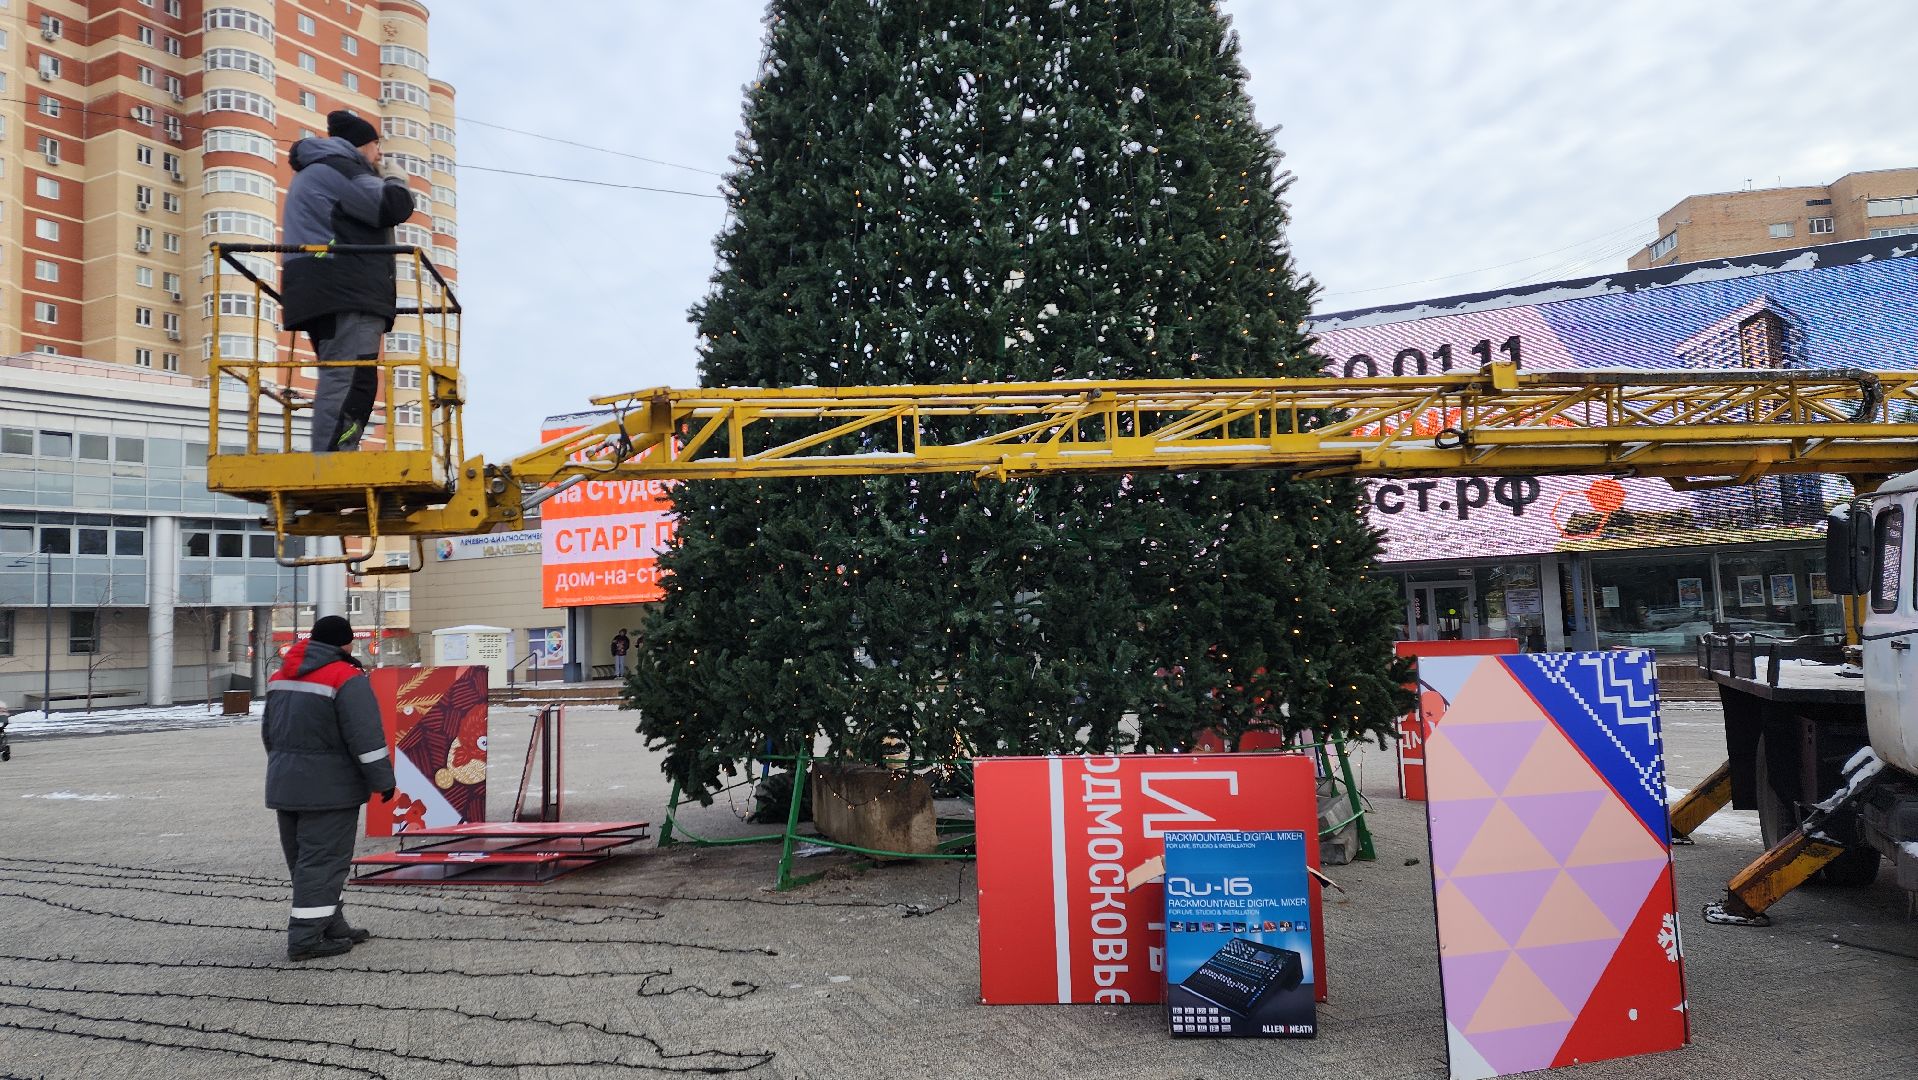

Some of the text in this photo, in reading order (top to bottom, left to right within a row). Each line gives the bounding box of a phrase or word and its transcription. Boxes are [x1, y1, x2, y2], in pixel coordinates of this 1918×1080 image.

[586, 479, 672, 505] Студе
[1360, 475, 1541, 521] ст.рф
[555, 523, 647, 554] СТАРТ
[555, 566, 664, 593] дом-на-ст
[1165, 832, 1303, 842] RACKMOUNTABLE DIGITAL MIXER
[1167, 877, 1253, 898] Qu-16
[1168, 898, 1307, 908] RACKMOUNTABLE DIGITAL MIXER
